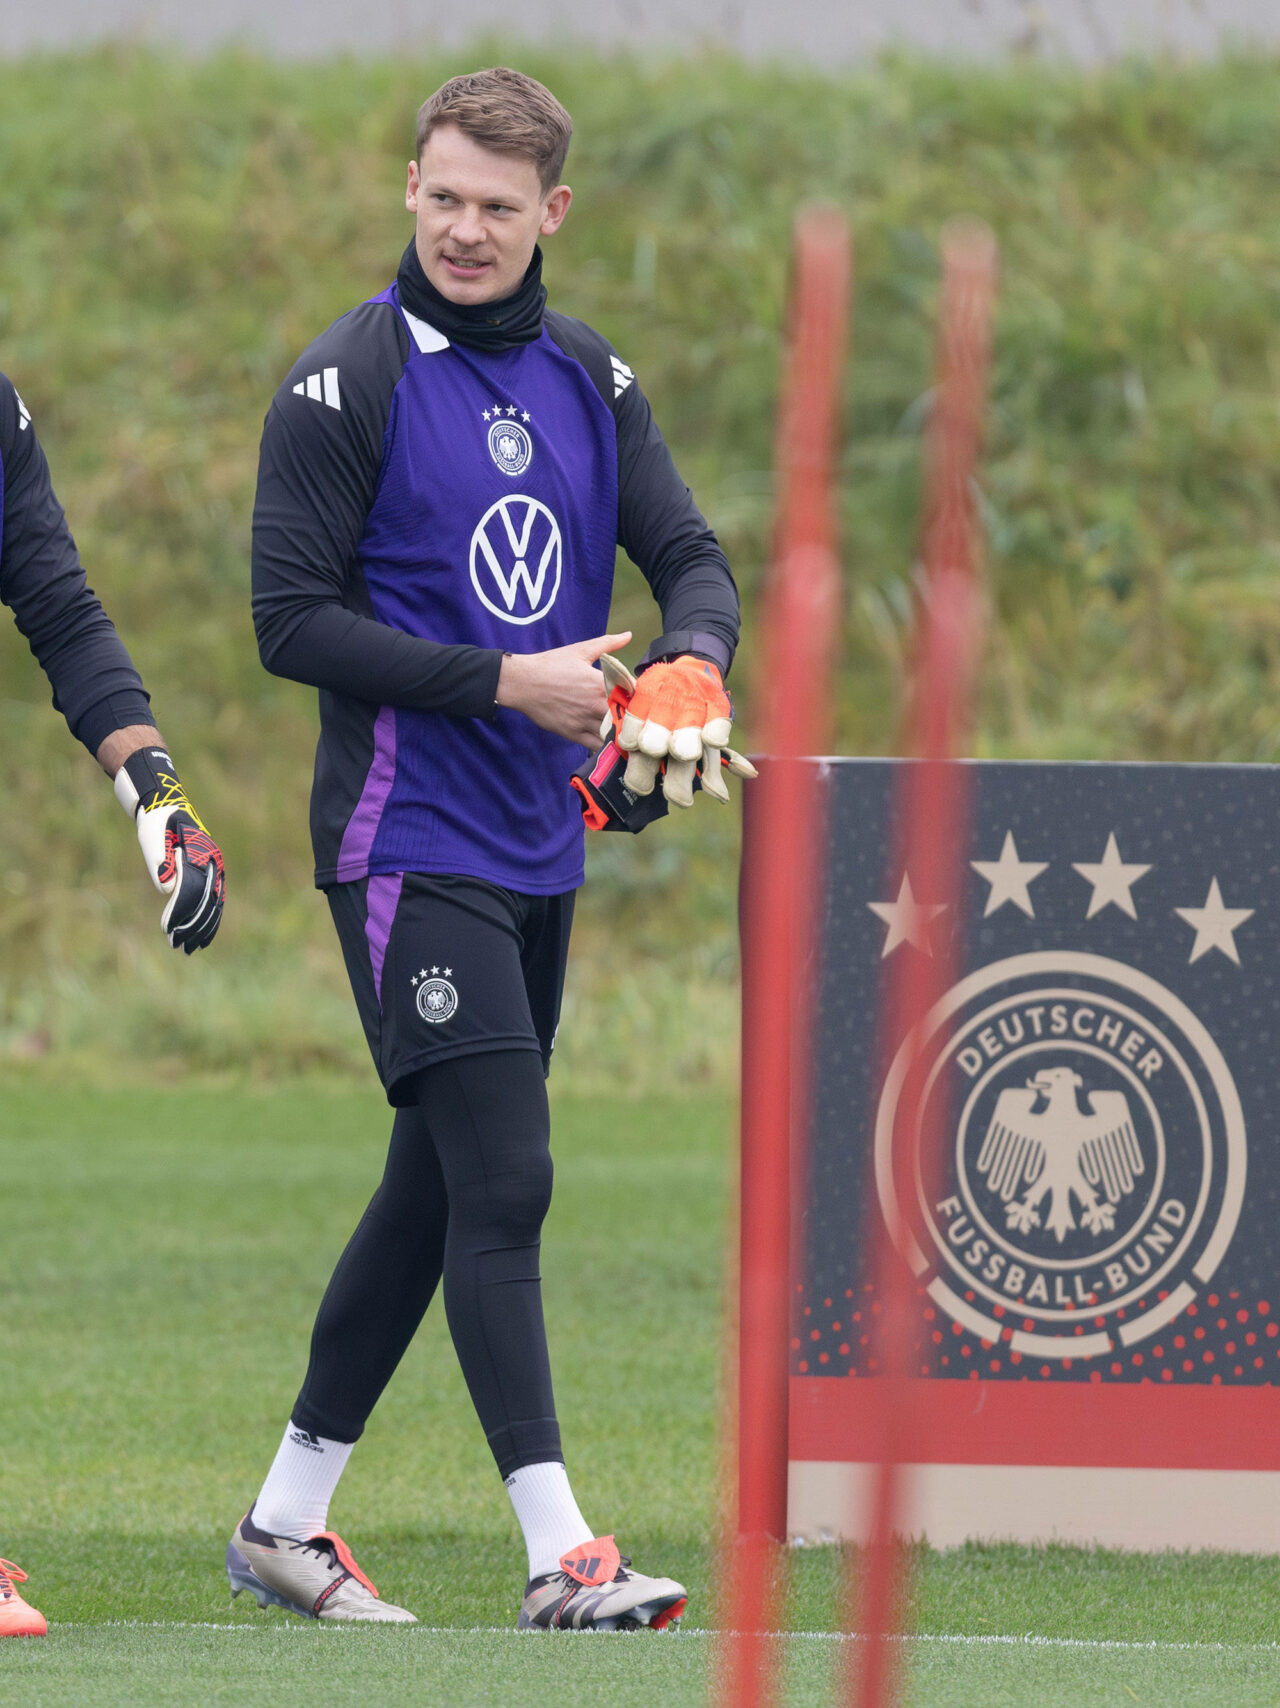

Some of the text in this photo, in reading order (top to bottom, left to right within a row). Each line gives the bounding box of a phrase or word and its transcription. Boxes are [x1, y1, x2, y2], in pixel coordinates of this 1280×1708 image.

[475, 500, 559, 612] VW
[955, 1004, 1164, 1080] DEUTSCHER
[935, 1195, 1188, 1305] FUSSBALL-BUND
[289, 1433, 325, 1454] adidas
